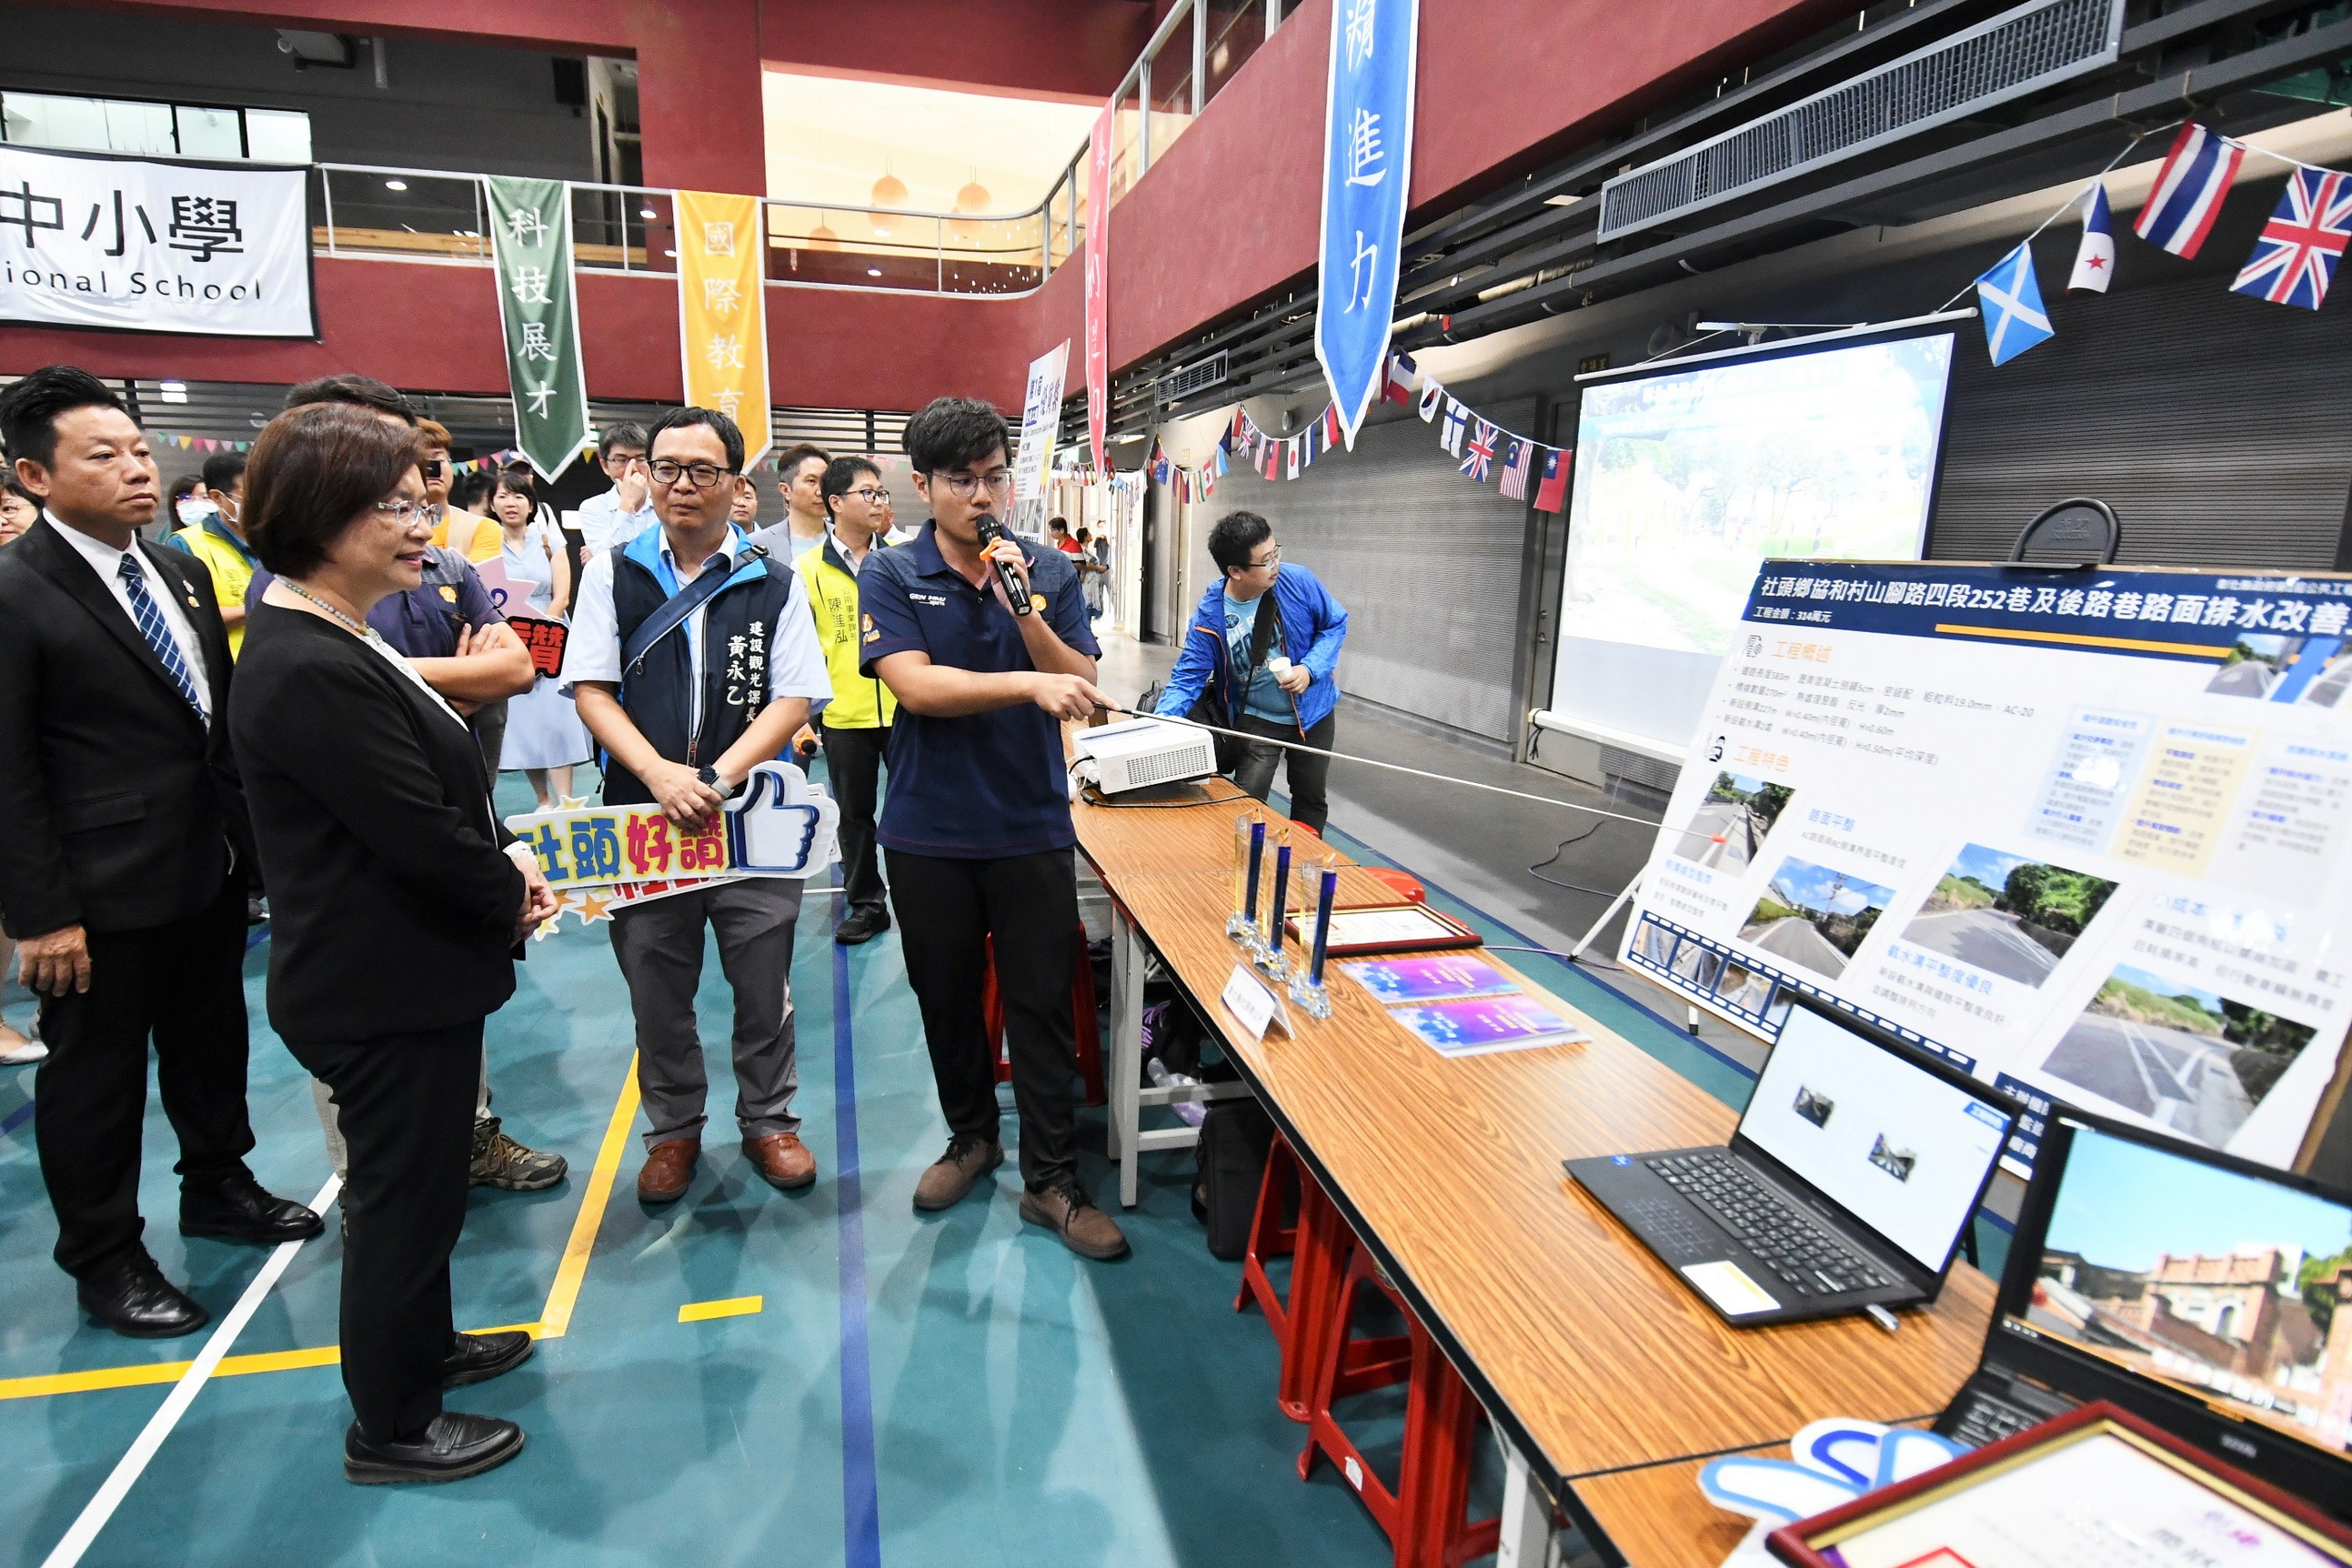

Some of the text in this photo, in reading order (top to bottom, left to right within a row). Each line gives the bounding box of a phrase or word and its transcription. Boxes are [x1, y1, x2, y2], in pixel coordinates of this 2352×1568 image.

[0, 181, 244, 262] 中小學
[130, 271, 261, 300] School
[505, 206, 558, 420] 科技展才
[702, 220, 746, 426] 國際教育
[827, 597, 849, 645] 陳進泓
[1760, 576, 2352, 636] 社頭鄉協和村山腳路四段252巷及後路巷路面排水改善
[726, 635, 748, 706] 黃永乙
[746, 620, 765, 723] 建設觀光課長
